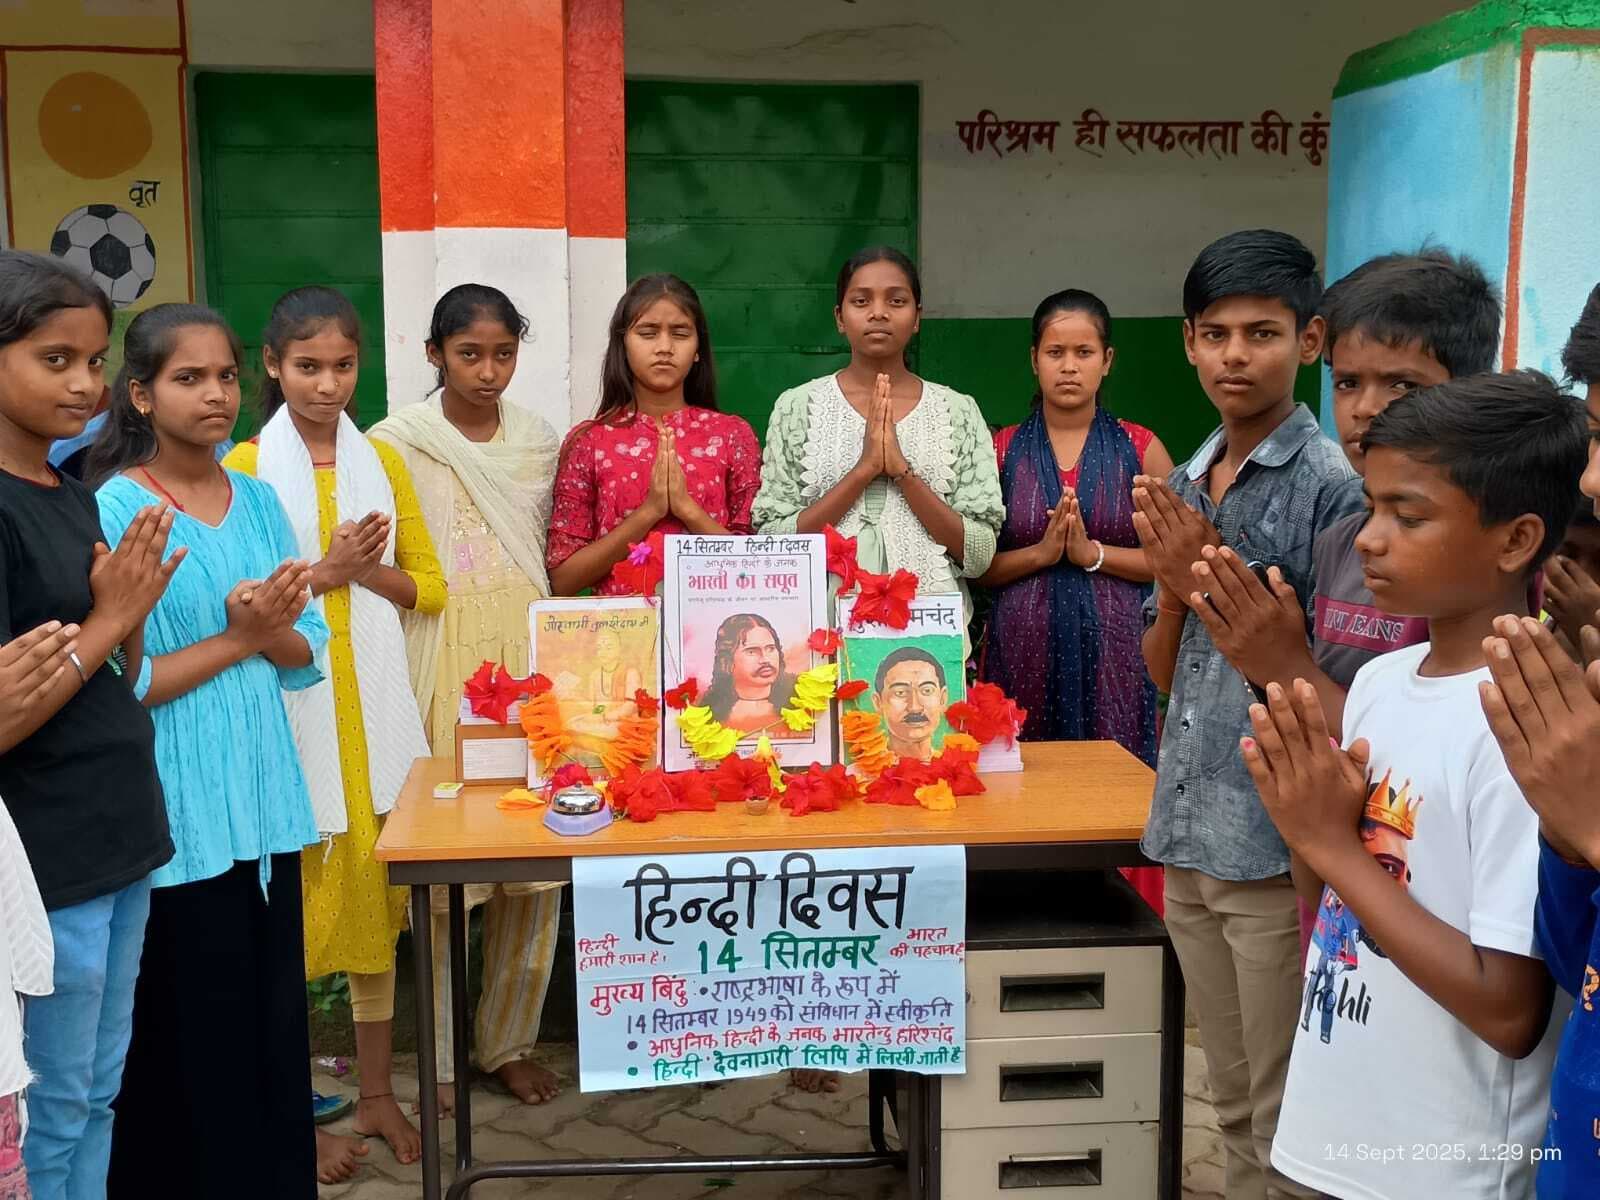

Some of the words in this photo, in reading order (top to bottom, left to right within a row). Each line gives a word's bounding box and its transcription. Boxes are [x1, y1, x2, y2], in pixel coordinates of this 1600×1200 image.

[955, 109, 1060, 157] परिश्रम
[1072, 109, 1110, 156] ही
[1116, 121, 1244, 160] सफलता
[1250, 110, 1293, 155] की
[1299, 111, 1331, 166] कुं
[677, 539, 692, 554] 14
[694, 537, 734, 553] सितम्बर
[745, 536, 777, 555] हिन्दी
[779, 538, 812, 555] दिवस
[763, 573, 798, 595] सपूत
[623, 856, 766, 945] हिन्दी
[774, 852, 914, 930] दिवस
[578, 933, 620, 954] हिन्दी
[698, 939, 742, 974] 14
[761, 931, 880, 970] सितम्बर
[889, 943, 910, 958] की
[906, 928, 947, 942] भारत
[590, 982, 645, 1016] मुख्य
[651, 974, 688, 1007] बिंदु
[711, 974, 805, 1002] राष्ट्रभाषा
[835, 975, 871, 1000] रूप
[876, 968, 901, 995] में
[627, 1014, 647, 1034] 14
[651, 1008, 719, 1034] सितम्बर
[727, 1006, 767, 1026] 1949
[769, 995, 795, 1022] को
[799, 1000, 861, 1024] संविधान
[864, 998, 882, 1020] में
[884, 997, 954, 1023] स्वीकृति
[648, 1032, 718, 1058] आधुनिक
[722, 1025, 765, 1049] हिन्दी
[767, 1021, 781, 1042] के
[786, 1026, 827, 1043] जनक
[832, 1020, 893, 1046] भारतेन्दु
[653, 1053, 703, 1081] हिन्दी
[801, 1044, 849, 1066] लिपि
[855, 1042, 873, 1066] में
[876, 1048, 917, 1066] लिखी
[916, 1048, 949, 1066] जाती
[949, 1046, 965, 1064] है
